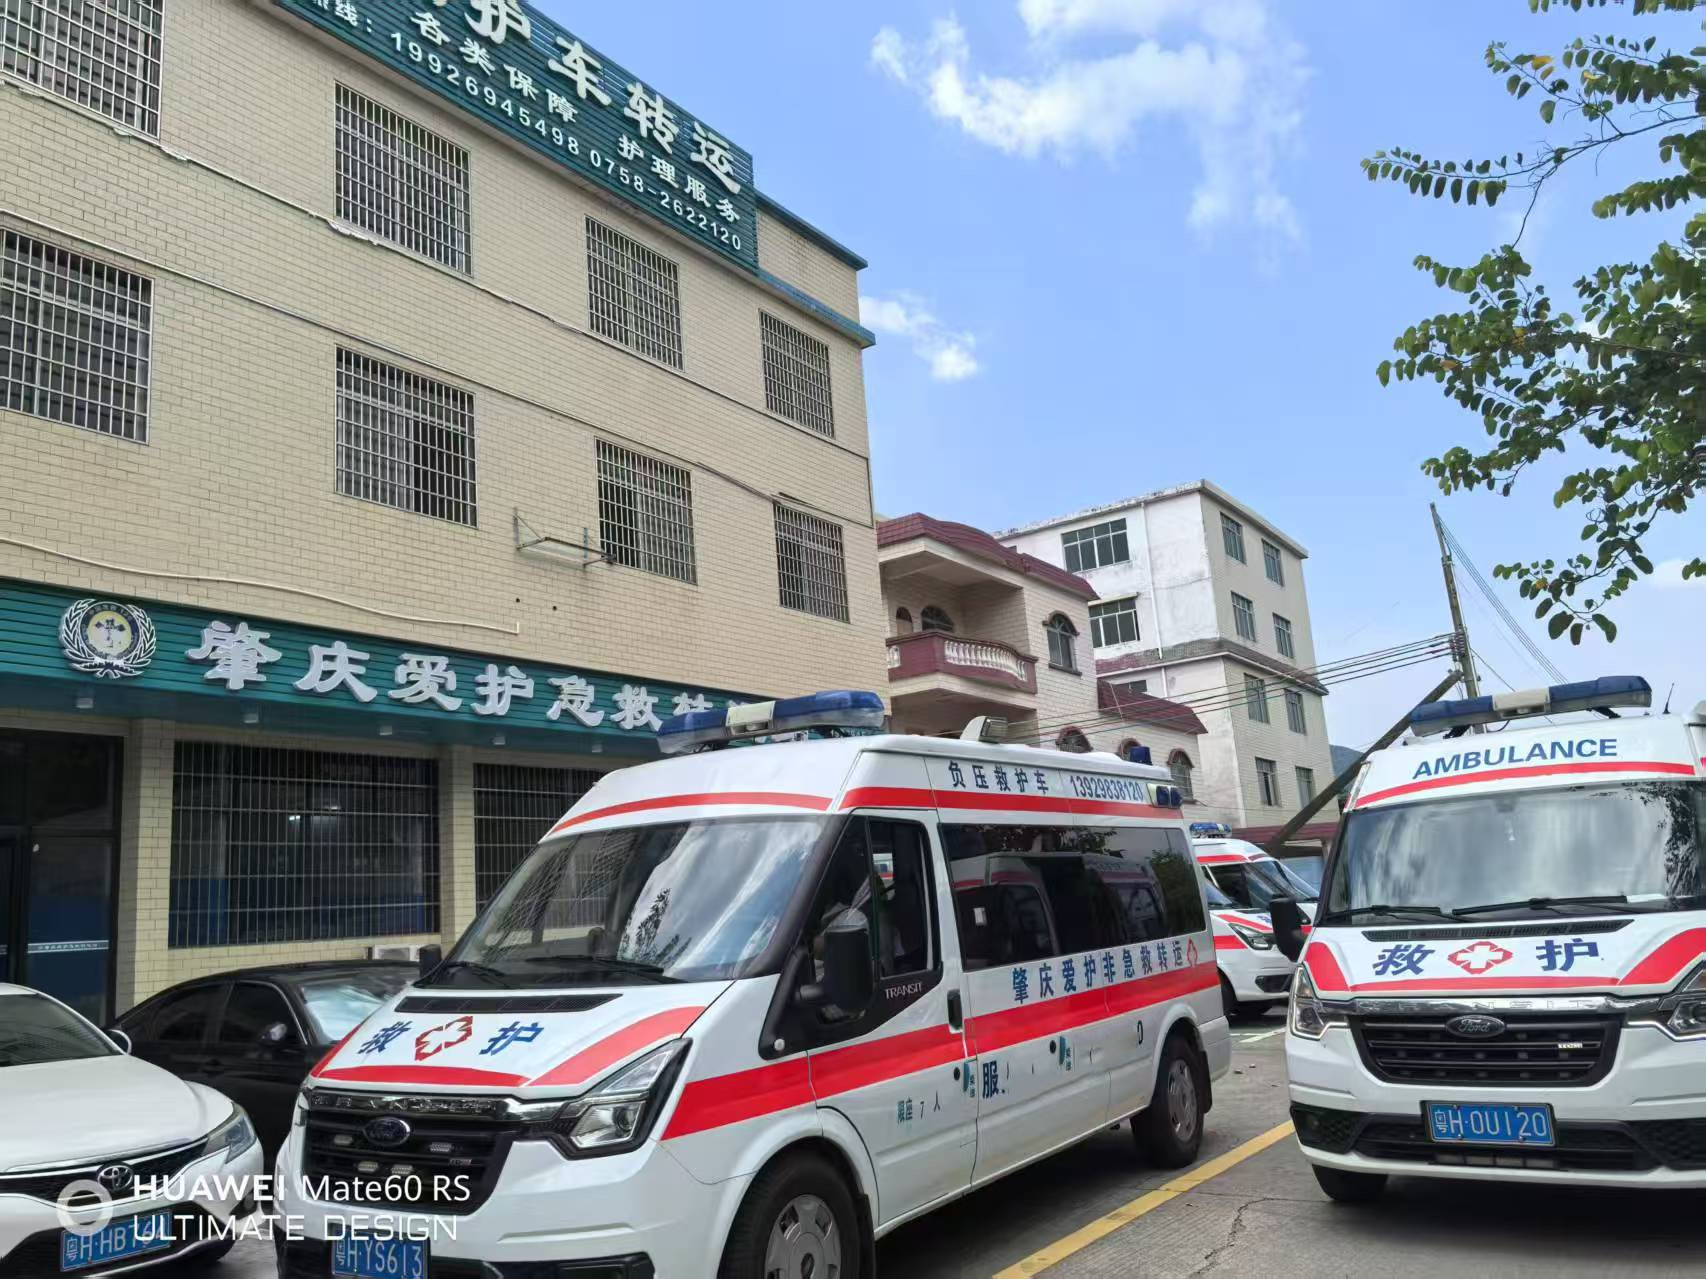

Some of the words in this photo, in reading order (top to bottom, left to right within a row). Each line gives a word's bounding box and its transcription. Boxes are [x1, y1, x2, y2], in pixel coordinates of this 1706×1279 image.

[410, 12, 579, 124] 各类保障
[617, 134, 741, 222] 护理服务
[433, 0, 741, 195] 护车转运
[391, 32, 580, 155] 19926945498
[590, 150, 741, 250] 0758-2622120
[185, 620, 751, 728] 肇庆爱护急救
[948, 760, 1049, 795] 负压救护车
[1069, 775, 1144, 801] 13929838120
[1412, 738, 1618, 780] AMBULANCE
[1012, 941, 1184, 1004] 肇庆爱护非急救转运
[1372, 944, 1436, 976] 救
[1535, 938, 1600, 972] 护
[885, 982, 922, 1000] TRANSIT
[357, 1020, 413, 1055] 救
[479, 1021, 545, 1057] 护
